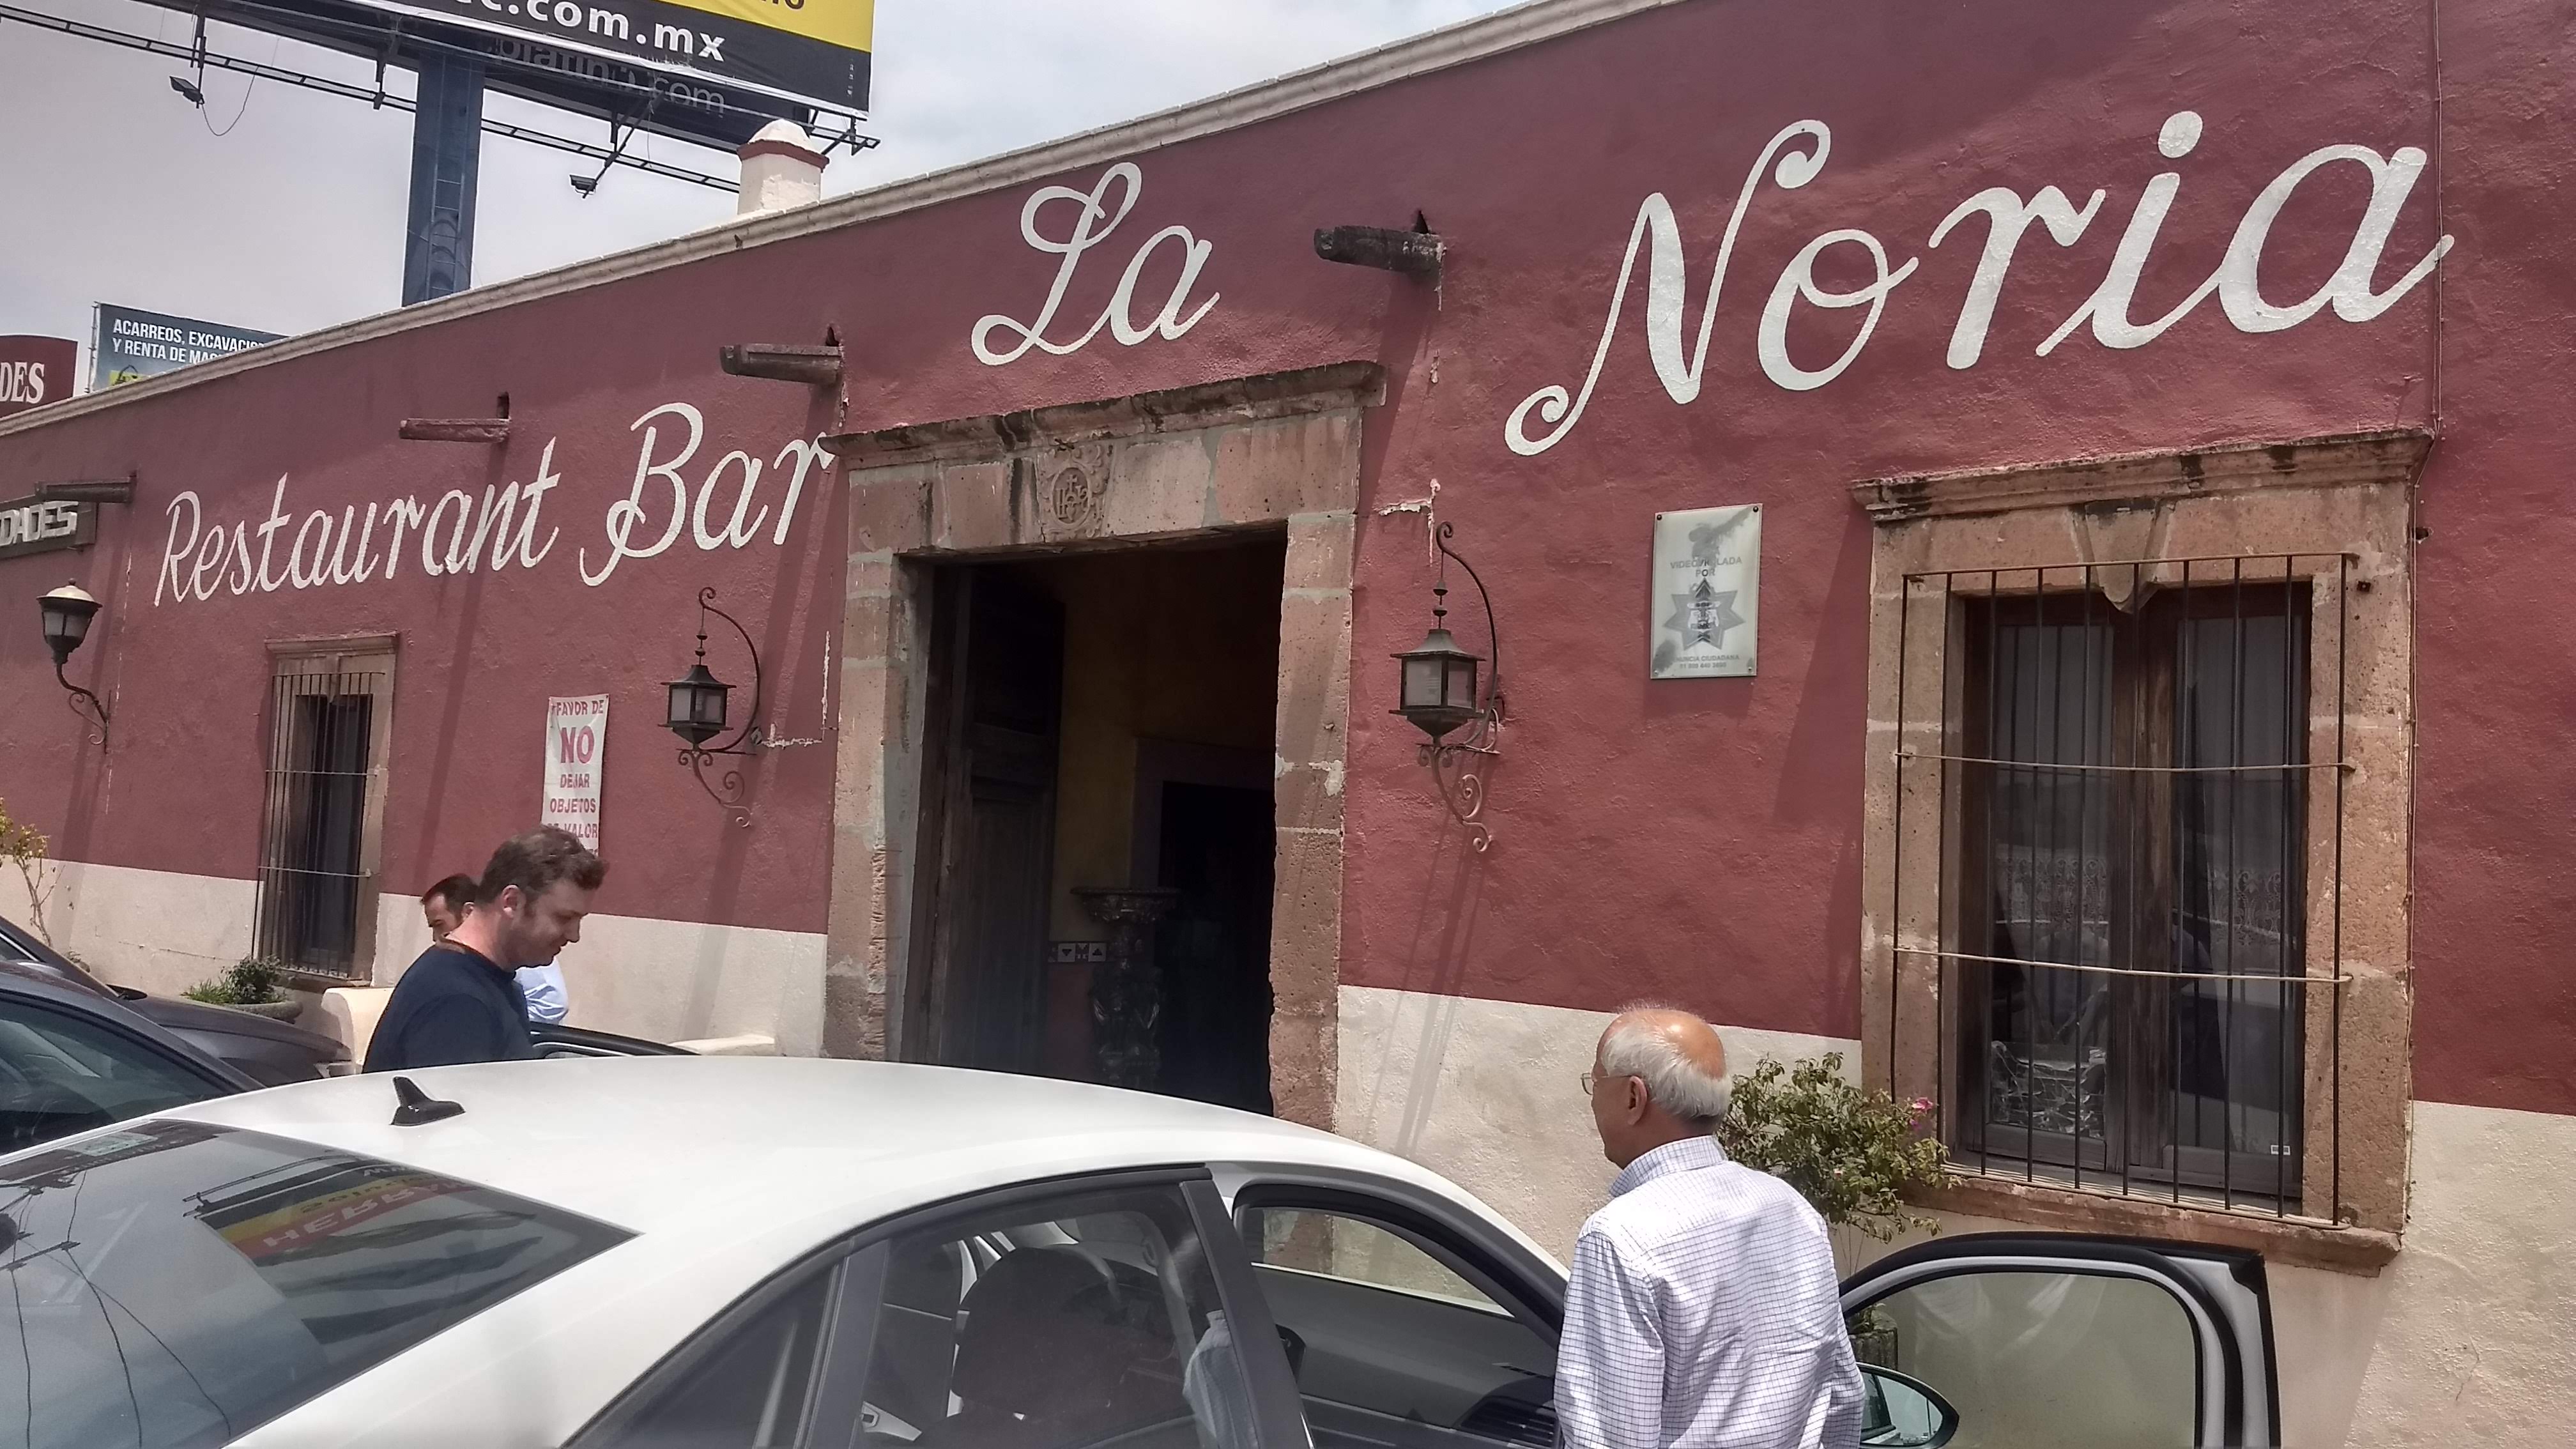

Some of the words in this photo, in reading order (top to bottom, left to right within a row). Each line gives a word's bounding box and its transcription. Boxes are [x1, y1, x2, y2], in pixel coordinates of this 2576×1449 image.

[971, 162, 1221, 365] La
[1505, 110, 2455, 456] Noria
[112, 319, 185, 345] ACARREOS,
[188, 330, 264, 352] EXCAVACI
[112, 337, 121, 352] Y
[125, 339, 166, 360] RENTA
[169, 346, 187, 363] DE
[189, 349, 224, 365] MA
[153, 436, 560, 607] Restaurant
[579, 402, 835, 587] Bar
[1695, 569, 1716, 578] POR
[592, 700, 604, 714] DE
[560, 725, 595, 763] NO
[560, 773, 590, 788] DEJAR
[549, 797, 597, 813] OBJETOS
